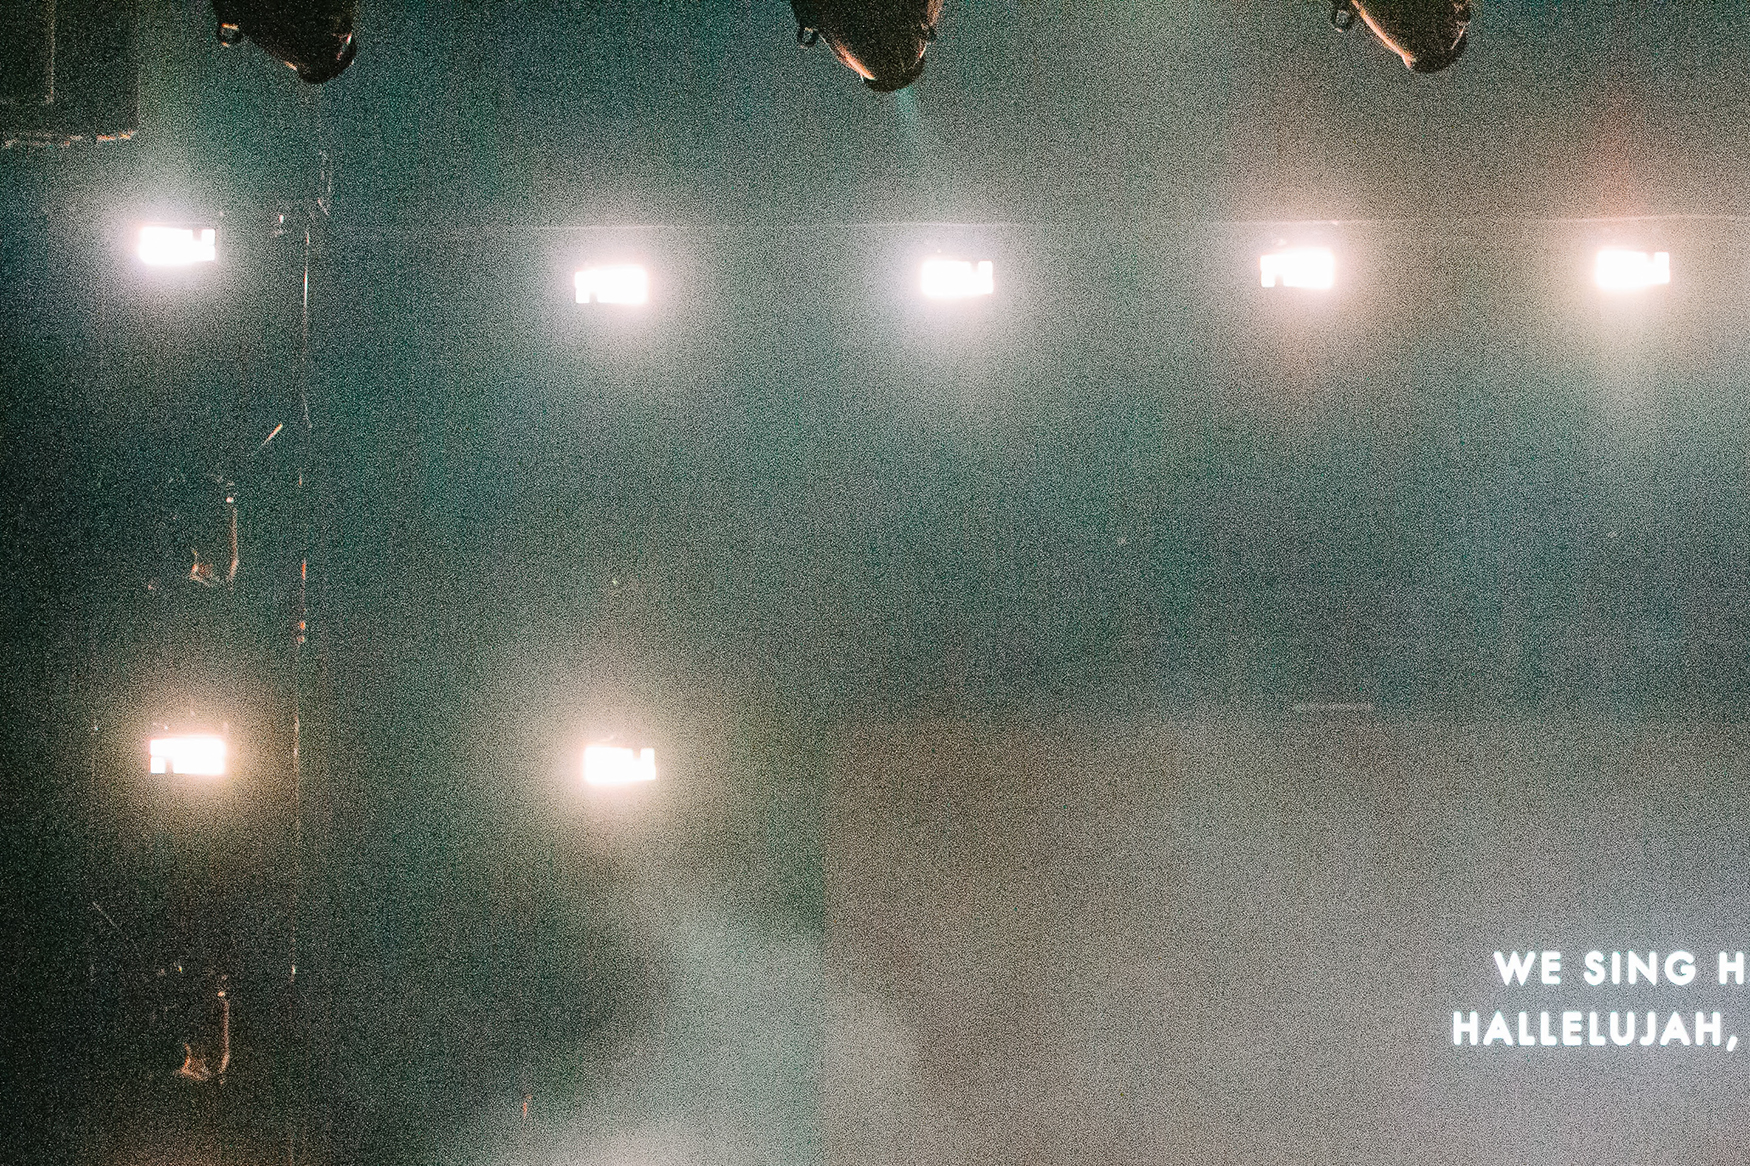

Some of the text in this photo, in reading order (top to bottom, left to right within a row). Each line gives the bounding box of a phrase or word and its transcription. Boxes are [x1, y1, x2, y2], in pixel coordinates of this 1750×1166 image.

[1493, 950, 1562, 986] WE
[1583, 950, 1697, 986] SING
[1452, 1010, 1738, 1052] HALLELUJAH,
